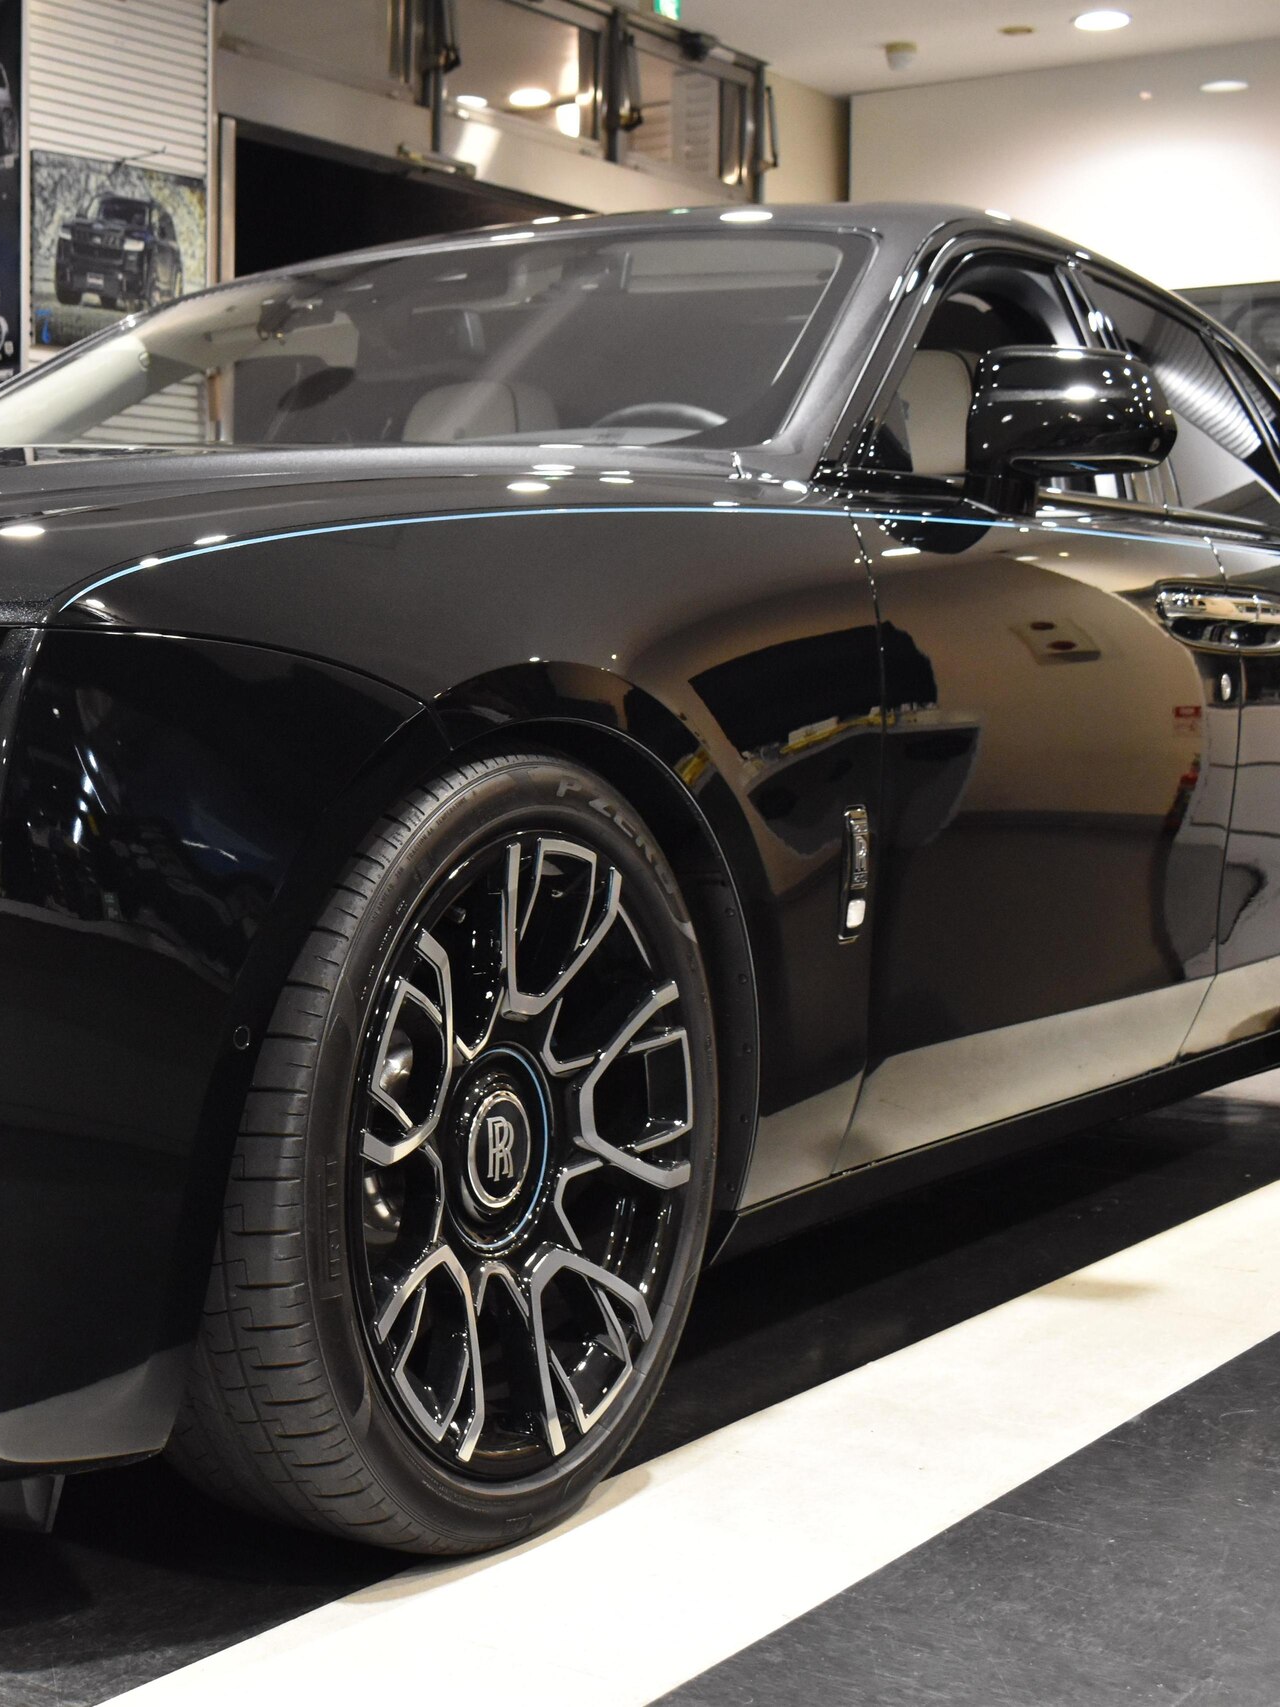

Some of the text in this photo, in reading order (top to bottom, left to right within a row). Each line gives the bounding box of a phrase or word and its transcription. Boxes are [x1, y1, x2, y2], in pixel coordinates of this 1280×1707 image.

[556, 778, 675, 895] P ZERO
[486, 1115, 515, 1182] RR
